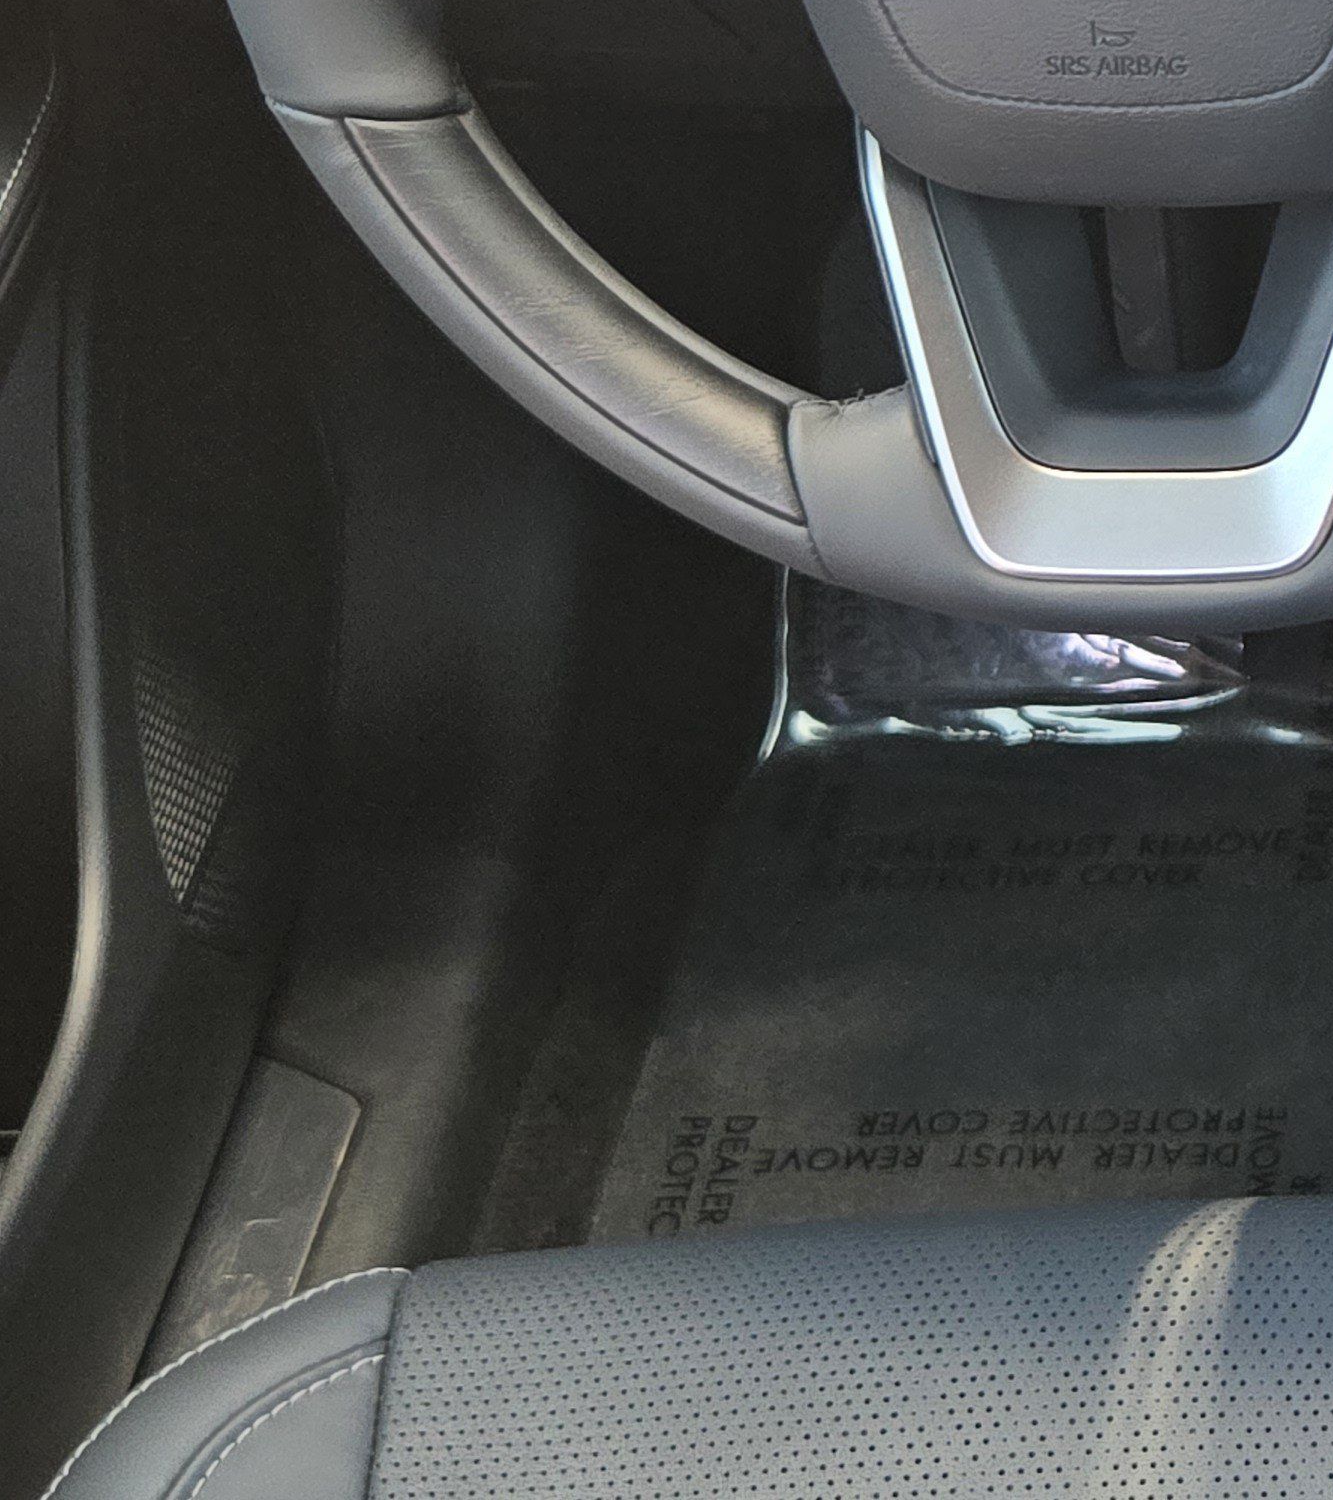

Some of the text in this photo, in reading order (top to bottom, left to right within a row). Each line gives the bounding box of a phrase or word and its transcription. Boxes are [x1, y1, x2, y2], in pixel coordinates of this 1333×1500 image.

[1046, 55, 1189, 77] SRS AIRBAG
[857, 1108, 1246, 1137] PROTECTIVE COVER
[695, 1115, 758, 1227] DEALER
[753, 1142, 1241, 1175] DEALER MUST REMOVE
